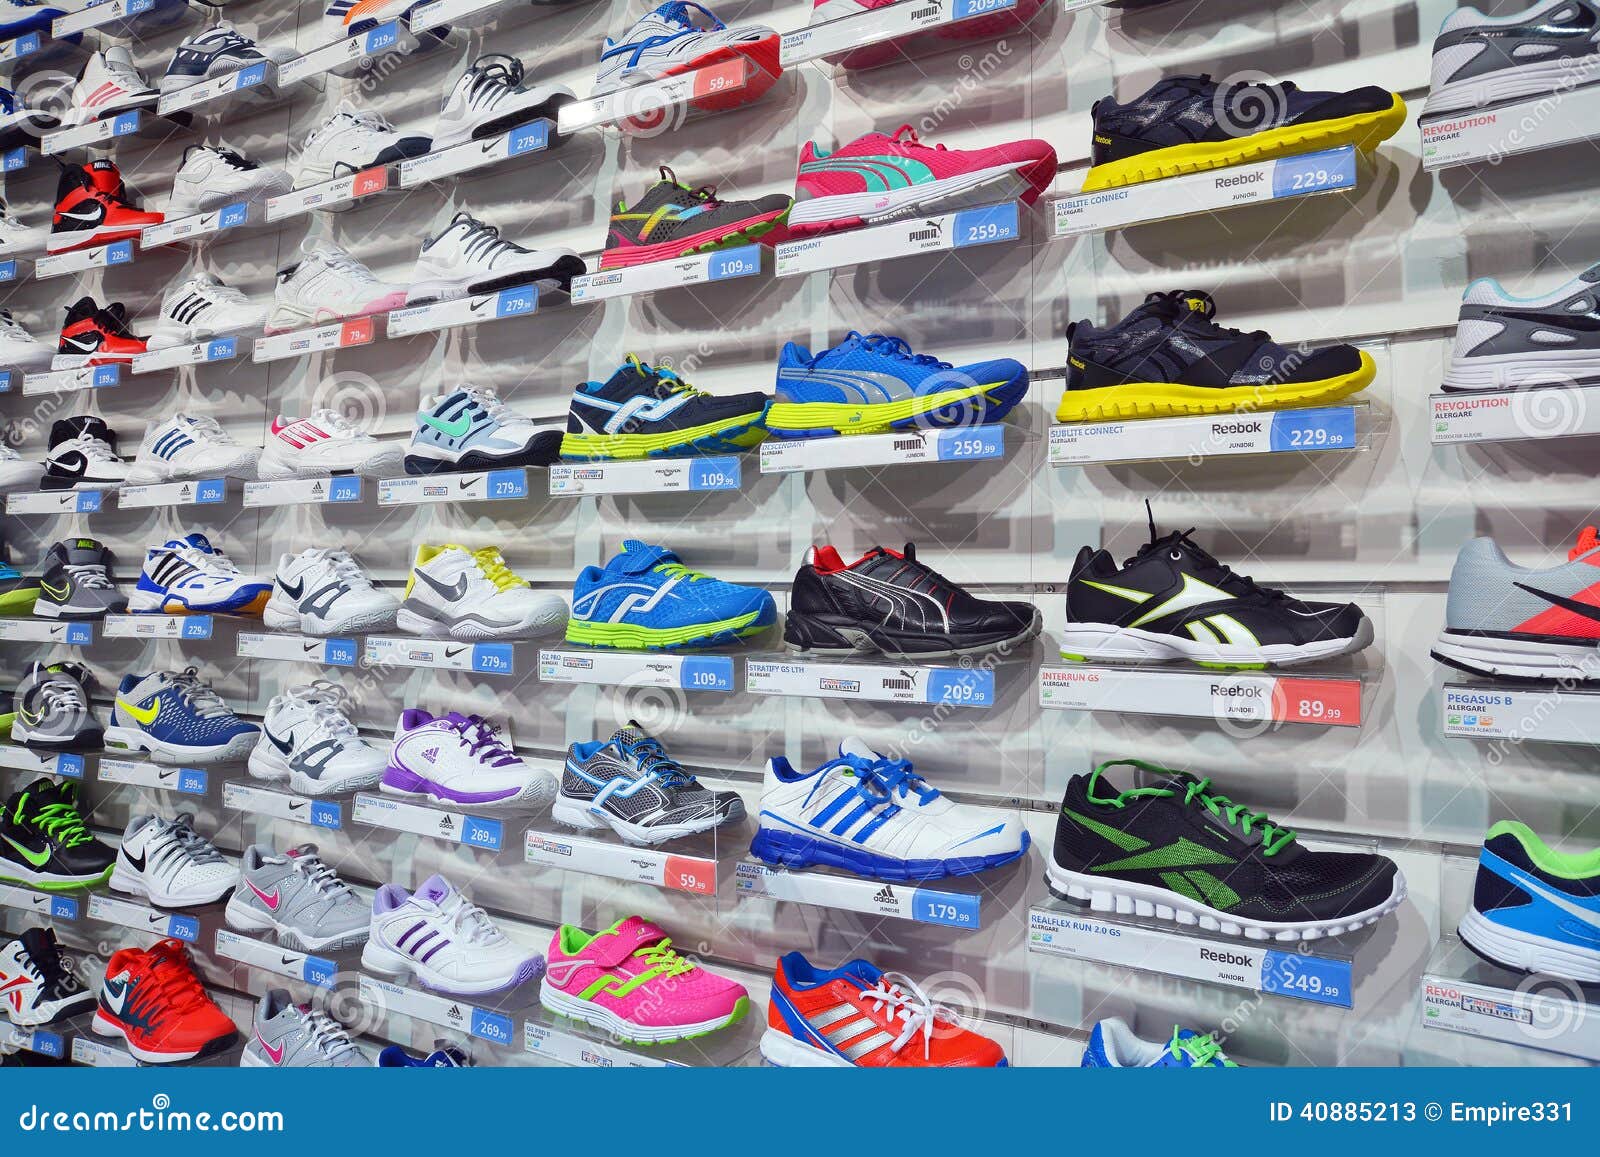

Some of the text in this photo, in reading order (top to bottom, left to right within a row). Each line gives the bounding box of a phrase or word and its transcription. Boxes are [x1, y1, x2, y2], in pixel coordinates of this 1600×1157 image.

[911, 6, 938, 21] PUMA
[783, 32, 813, 45] STRATIFY
[709, 76, 733, 91] 59,99
[1423, 115, 1497, 137] REVOLUTION
[1423, 132, 1461, 145] ALERGARE
[1215, 171, 1265, 189] Reebok
[1292, 169, 1345, 190] 229,99
[1056, 191, 1129, 211] SUBLITE CONNECT
[1232, 191, 1258, 200] JUNIORI
[909, 228, 938, 243] PUMA
[968, 223, 1010, 241] 259,99
[778, 241, 822, 256] DESCENDANT
[719, 260, 753, 276] 109,99
[1435, 398, 1510, 412] REVOLUTION
[1435, 411, 1473, 419] ALERGARE
[1050, 425, 1125, 438] SUBLITE CONNECT
[1212, 422, 1263, 435] Reebok
[893, 438, 923, 451] PUMA
[1291, 428, 1344, 446] 229,99
[762, 441, 806, 451] DESCENDANT
[953, 440, 995, 457] 259,99
[701, 473, 733, 487] 109,99
[749, 664, 778, 673] STRATIFY
[791, 666, 804, 674] LTH
[693, 672, 726, 687] 109,99
[882, 678, 911, 690] PUMA
[1042, 672, 1100, 682] INTERRUN GS
[943, 685, 985, 701] 209,99
[1210, 684, 1263, 698] Reebok
[1447, 693, 1513, 706] PEGASUS B
[1299, 700, 1341, 720] 89,99
[1447, 705, 1487, 713] ALERGARE
[736, 864, 764, 875] ADIFAST
[680, 873, 706, 890] 59,99
[873, 894, 899, 905] adidas
[928, 903, 970, 922] 179,99
[1031, 914, 1122, 938] REALFLEX RUN 2.0 GS
[1200, 948, 1253, 968] Reebok
[1218, 973, 1245, 983] JUNIORI
[1283, 971, 1340, 997] 249,99
[1426, 985, 1461, 1000] REVO
[1426, 995, 1461, 1008] ALERGAR
[1469, 1004, 1529, 1021] EXCLUSIVE
